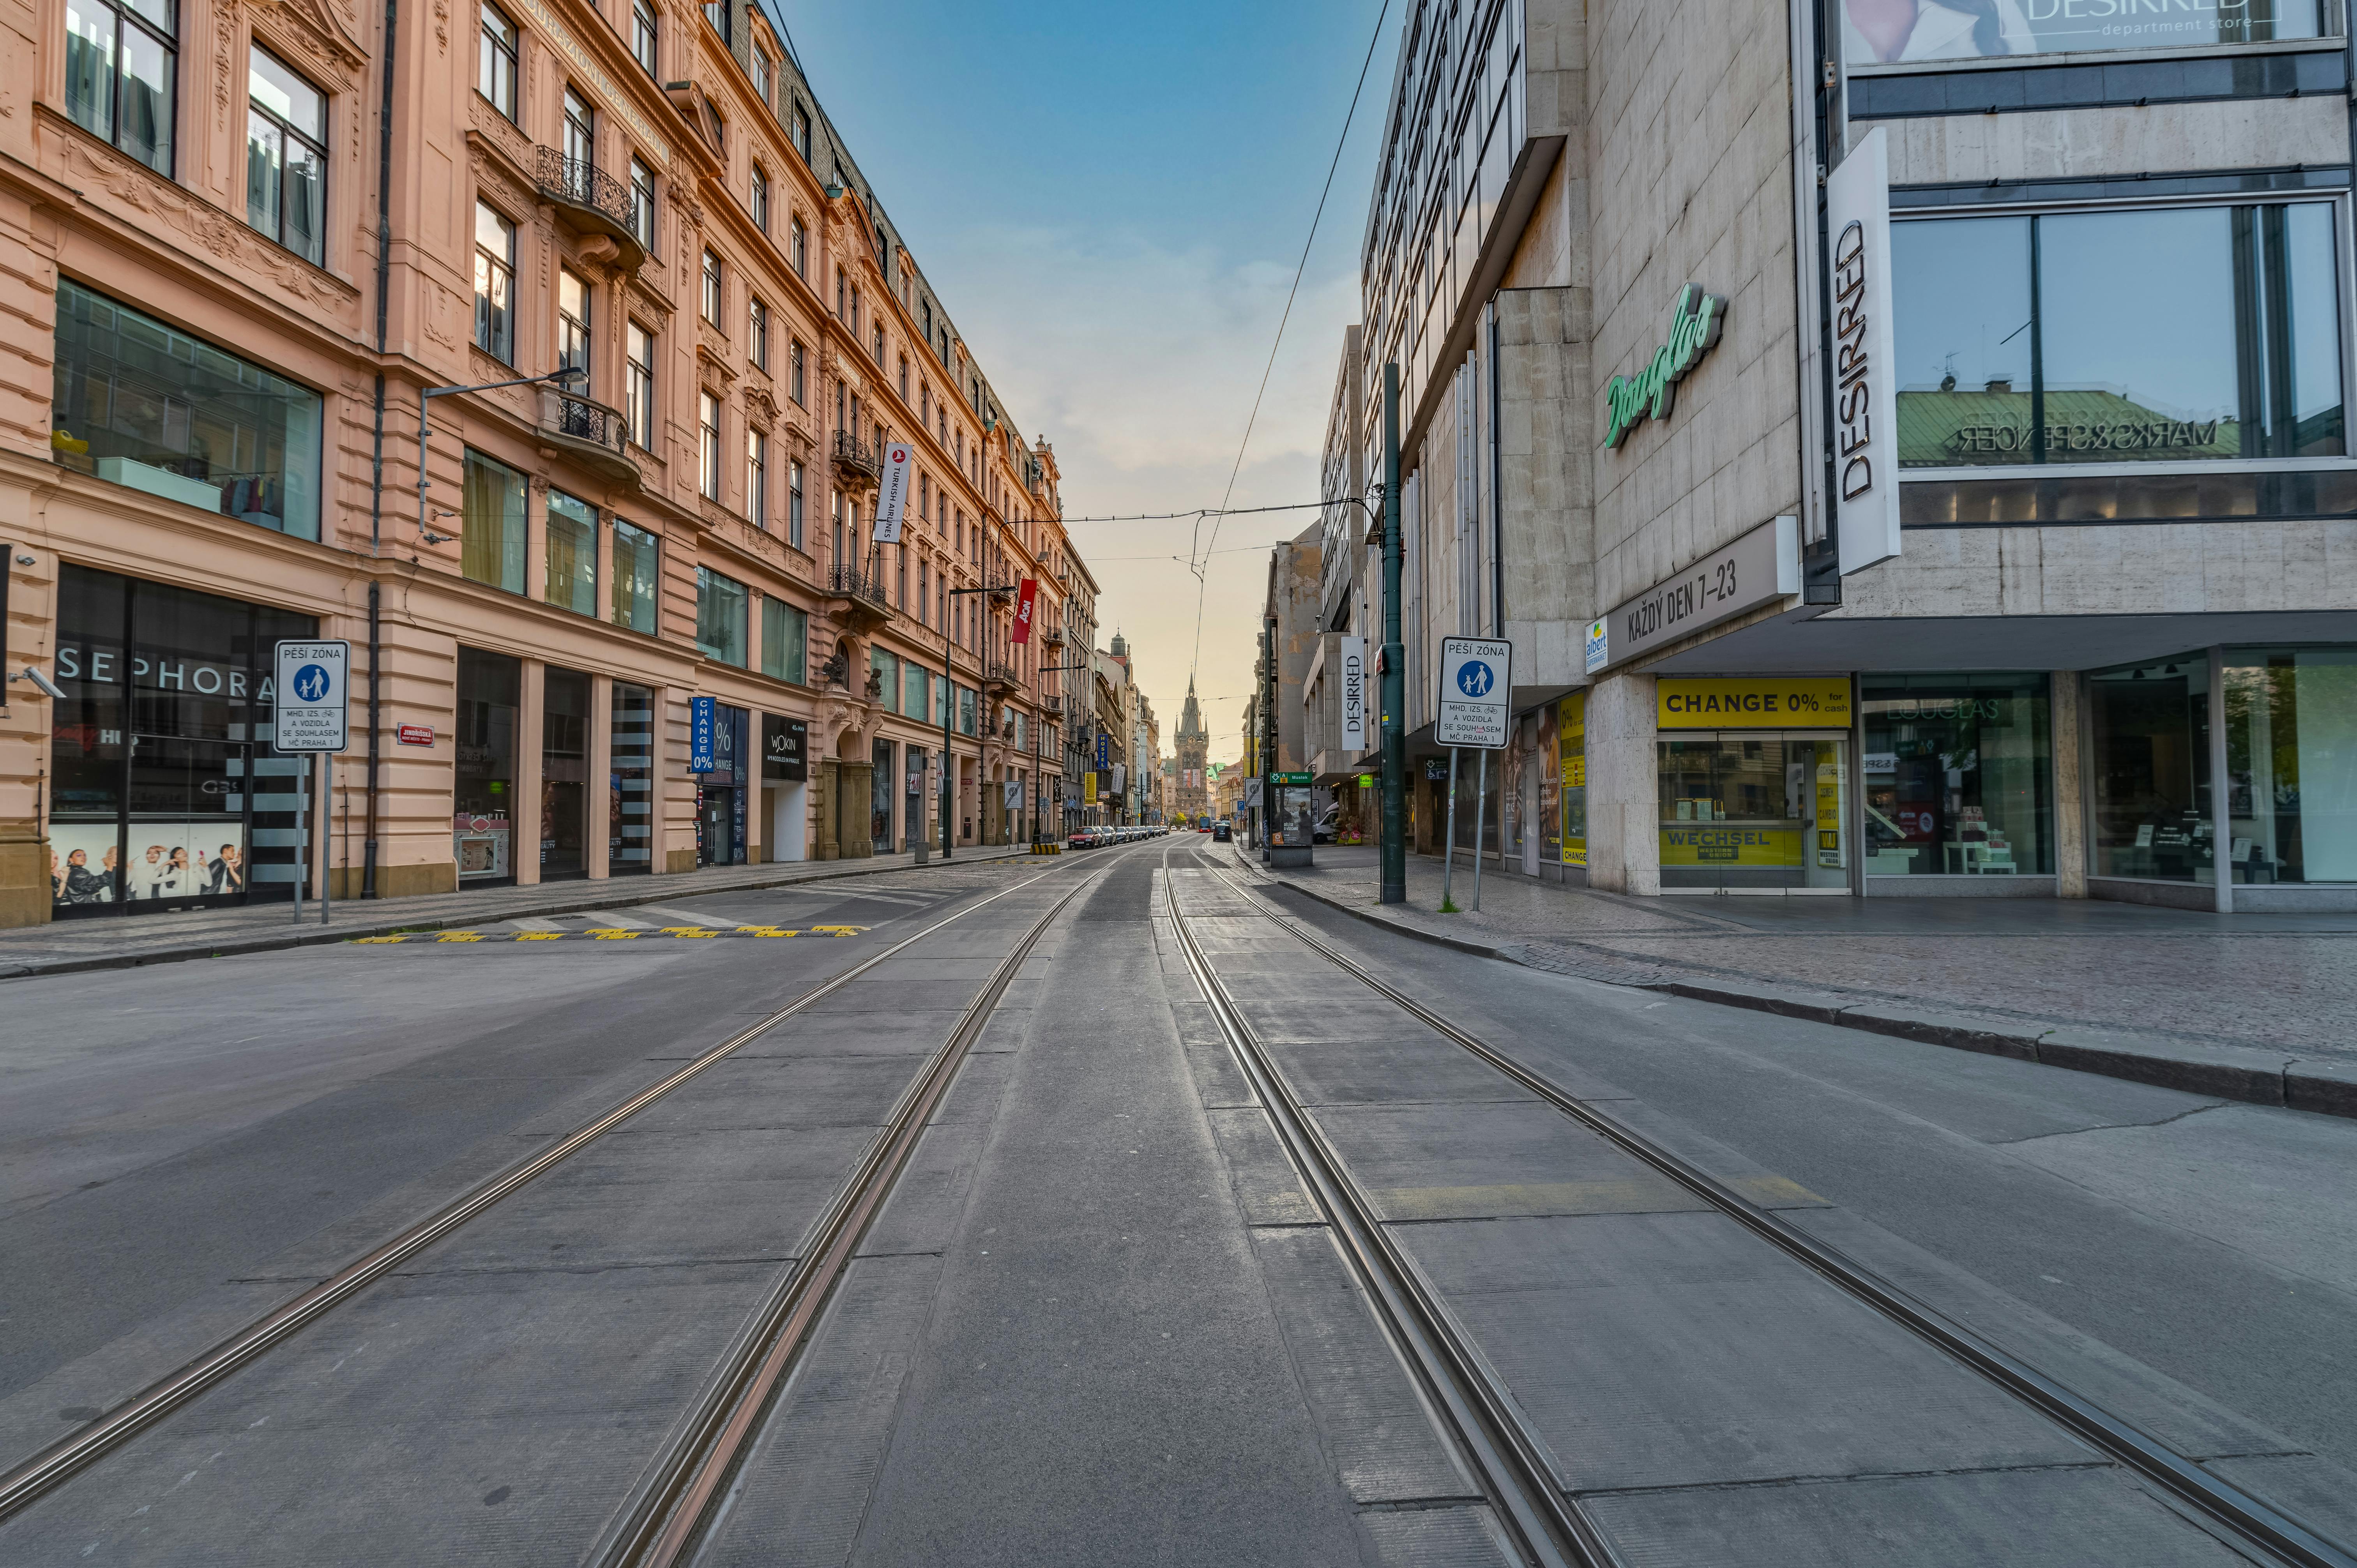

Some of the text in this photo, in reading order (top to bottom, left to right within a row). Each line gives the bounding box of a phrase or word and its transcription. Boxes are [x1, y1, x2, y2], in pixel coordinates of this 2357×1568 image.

[2102, 18, 2253, 37] department store
[1604, 282, 1718, 449] Douglas
[1836, 219, 1873, 502] DESIRRED
[884, 467, 901, 538] TURKISH AIRLINES
[1628, 590, 1663, 643] KAŽDÝ
[1668, 581, 1693, 625] DEN
[1449, 643, 1505, 657] PĚŠÍ ZÓNA
[1587, 632, 1606, 656] albert
[284, 647, 341, 659] PĚŠÍ ZÓNA
[1587, 652, 1606, 667] SUPERMARKET
[58, 648, 274, 700] SEPHORA
[1347, 655, 1360, 732] DESIRRED
[1829, 692, 1843, 701] for
[1666, 694, 1819, 713] CHANGE 0%
[1825, 704, 1848, 712] cash
[1887, 699, 1999, 720] DOUGLAS
[1562, 707, 1573, 730] 0%
[699, 700, 708, 753] CHANGE
[772, 735, 795, 752] WOKIN
[1817, 743, 1834, 755] CHANGE
[694, 756, 712, 768] 0%
[716, 759, 732, 771] HANGE
[704, 771, 732, 783] CENTRUM
[735, 766, 745, 781] 0%
[1819, 809, 1836, 821] CAMBIO
[1667, 832, 1770, 845] WECHSEL
[734, 848, 744, 858] 0%
[1565, 851, 1587, 862] CHANGE
